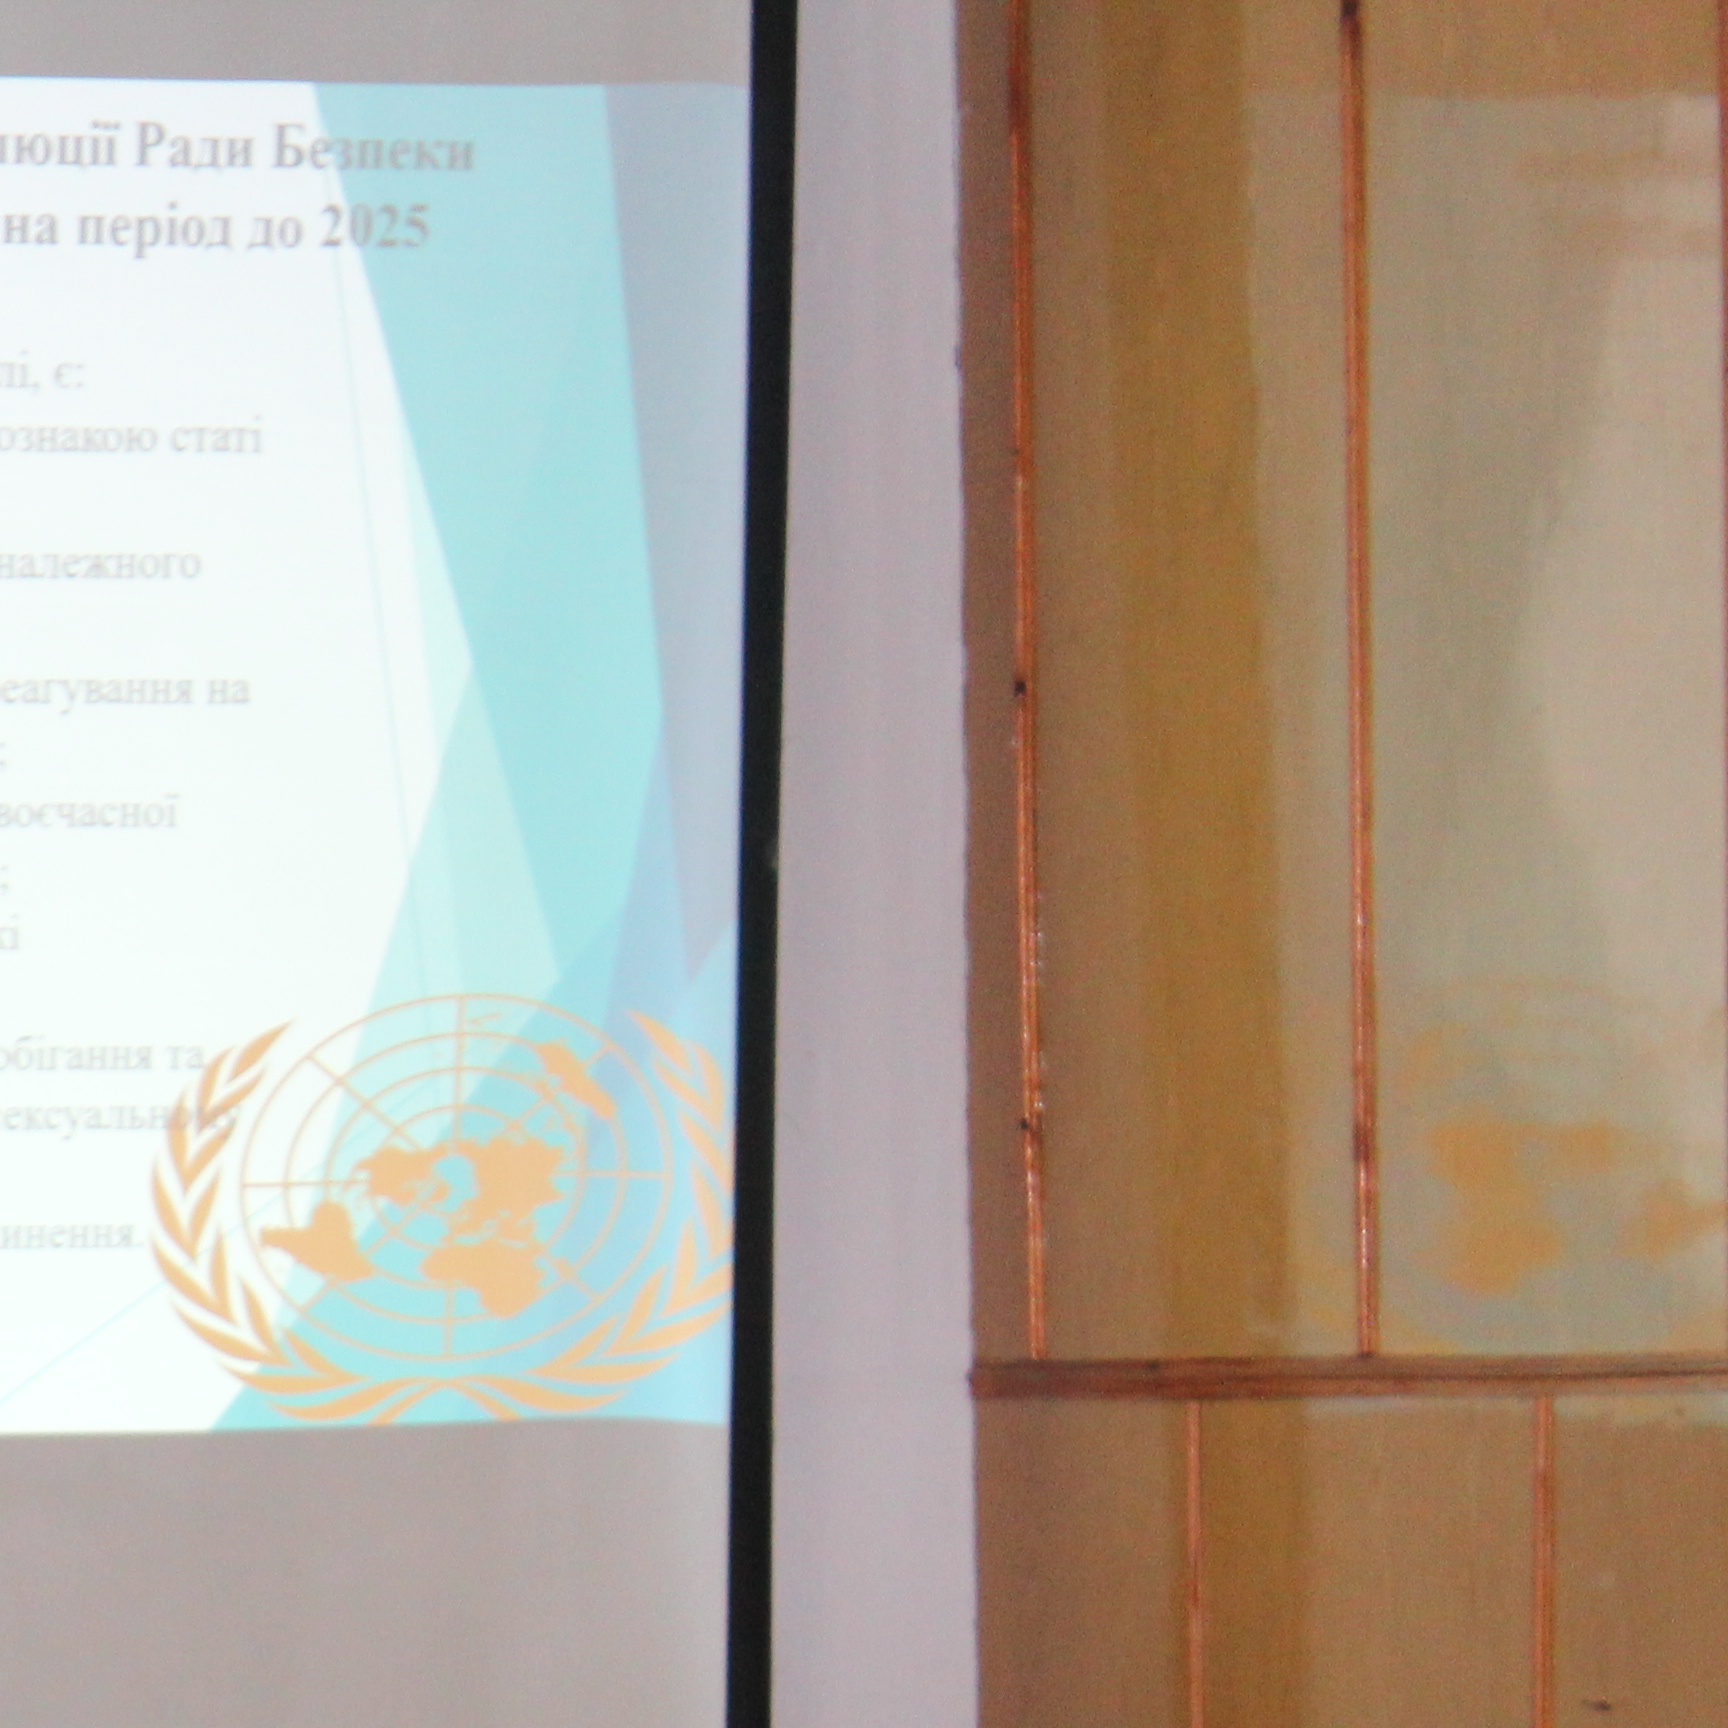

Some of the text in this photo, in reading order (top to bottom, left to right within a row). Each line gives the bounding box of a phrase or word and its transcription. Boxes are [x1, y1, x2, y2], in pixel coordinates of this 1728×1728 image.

[135, 121, 254, 172] Ради
[272, 124, 474, 171] Безпеки
[1, 213, 60, 247] на
[77, 201, 233, 261] період
[246, 216, 304, 251] до
[320, 203, 430, 249] 2025
[169, 417, 263, 456] статі
[206, 679, 251, 706] на
[168, 1046, 205, 1072] та
